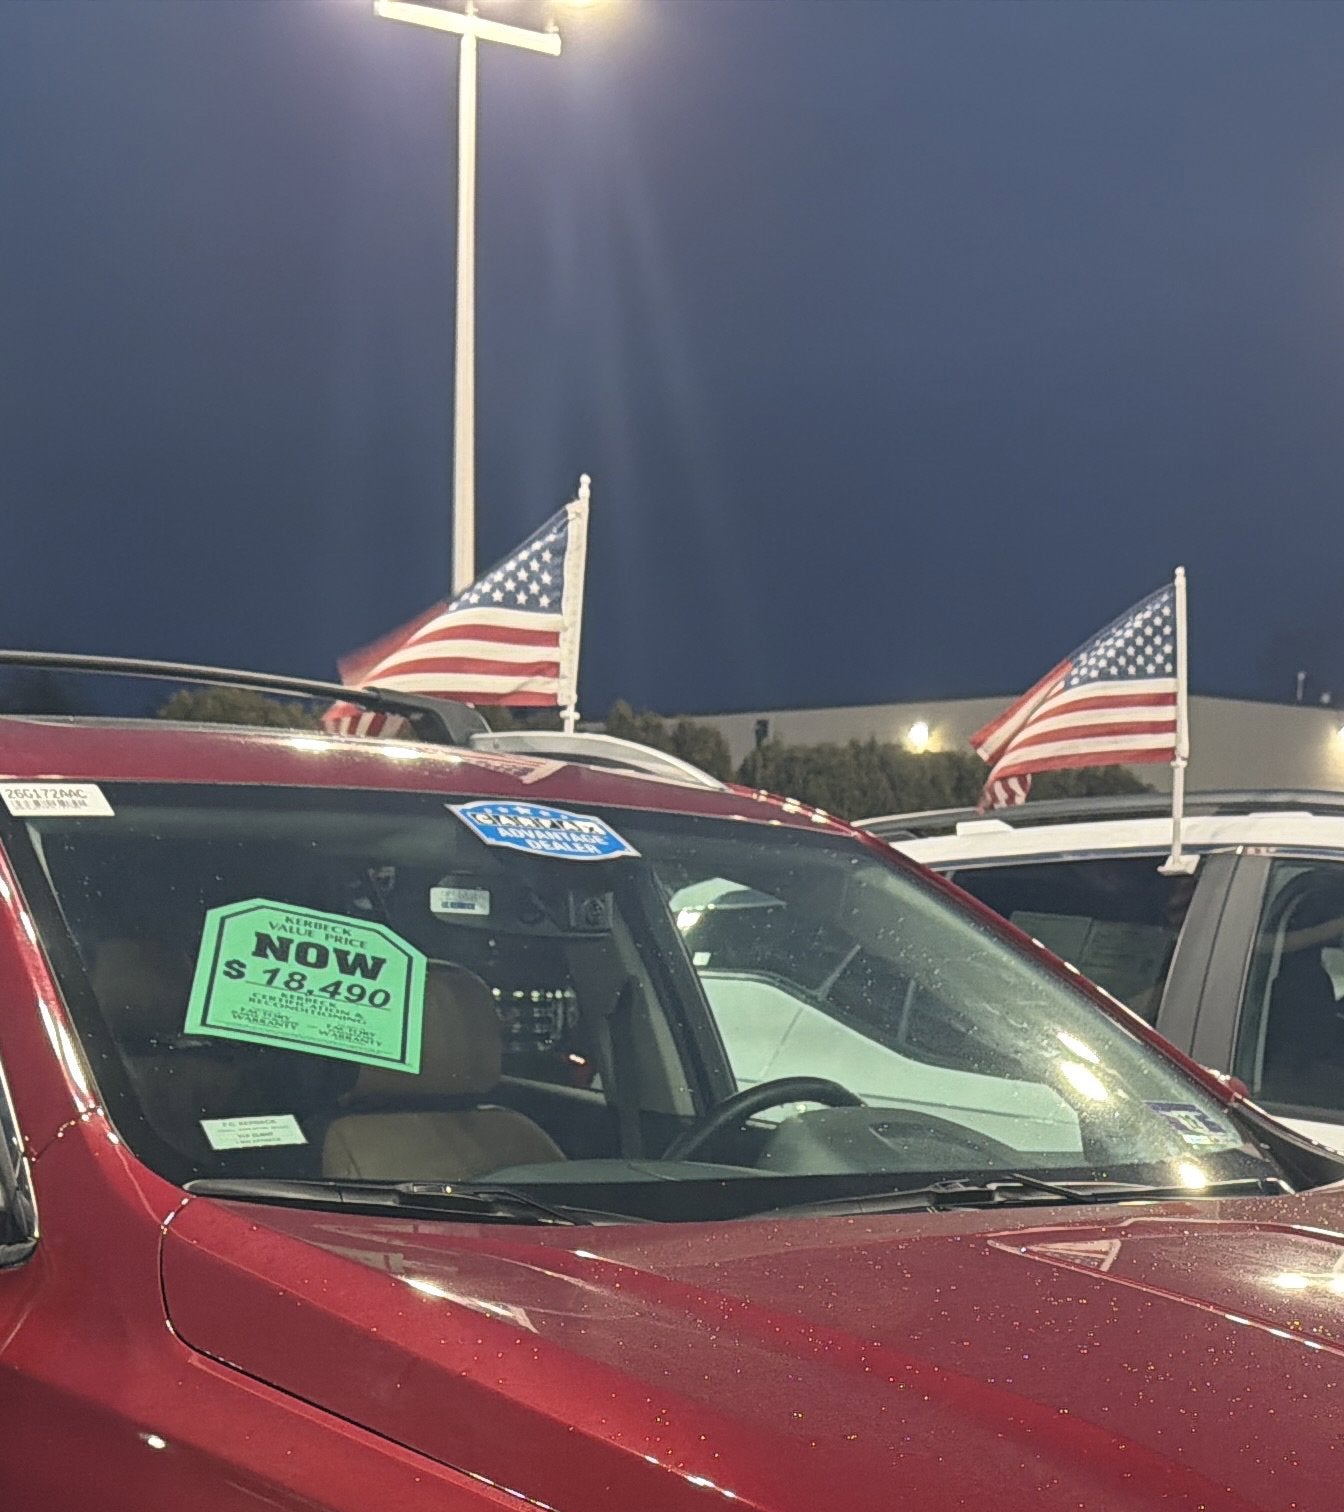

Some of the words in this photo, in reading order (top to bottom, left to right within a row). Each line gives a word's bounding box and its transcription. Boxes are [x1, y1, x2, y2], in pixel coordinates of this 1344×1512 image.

[497, 827, 610, 846] ADVANTAGE
[524, 838, 602, 855] DEALER
[267, 921, 315, 939] VALUE
[324, 933, 368, 950] PRICE
[284, 915, 353, 937] KERBECK
[250, 931, 387, 982] NOW
[222, 958, 247, 980] $
